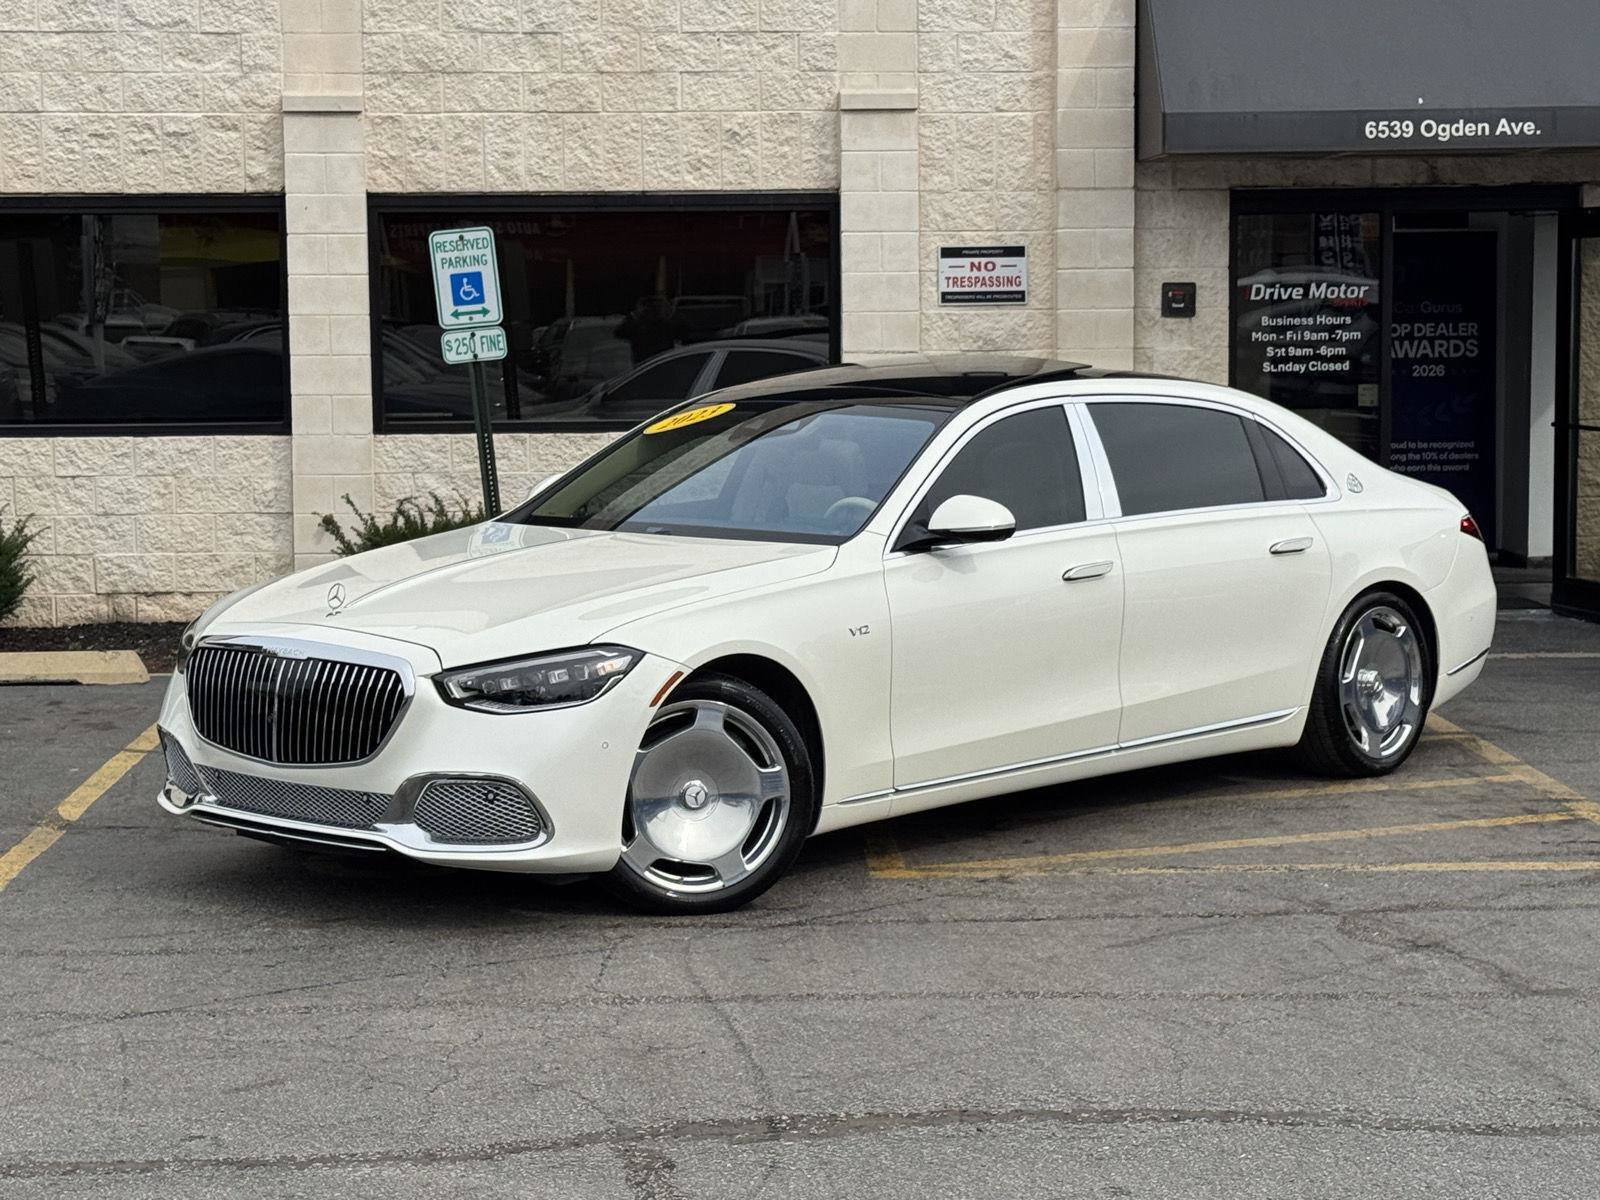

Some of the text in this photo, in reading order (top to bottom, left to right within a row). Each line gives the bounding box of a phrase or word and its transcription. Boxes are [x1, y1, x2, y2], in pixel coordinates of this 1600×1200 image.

[1365, 118, 1541, 141] 6539 Ogden Ave.
[435, 237, 490, 253] RESERVED
[441, 254, 488, 270] PARKING
[970, 261, 997, 272] NO
[945, 276, 1022, 288] TRESPASSING
[1250, 282, 1369, 300] Drive Motor
[1261, 315, 1352, 326] Business Hours
[1391, 322, 1479, 337] OP DEALER
[1251, 332, 1277, 342] Mon
[1303, 331, 1329, 341] 9am
[480, 334, 504, 353] FINE
[1288, 346, 1313, 356] 9am
[1262, 361, 1350, 374] Sunday Closed
[1412, 365, 1445, 377] 2026
[1390, 441, 1407, 449] oud
[1390, 453, 1406, 462] ong
